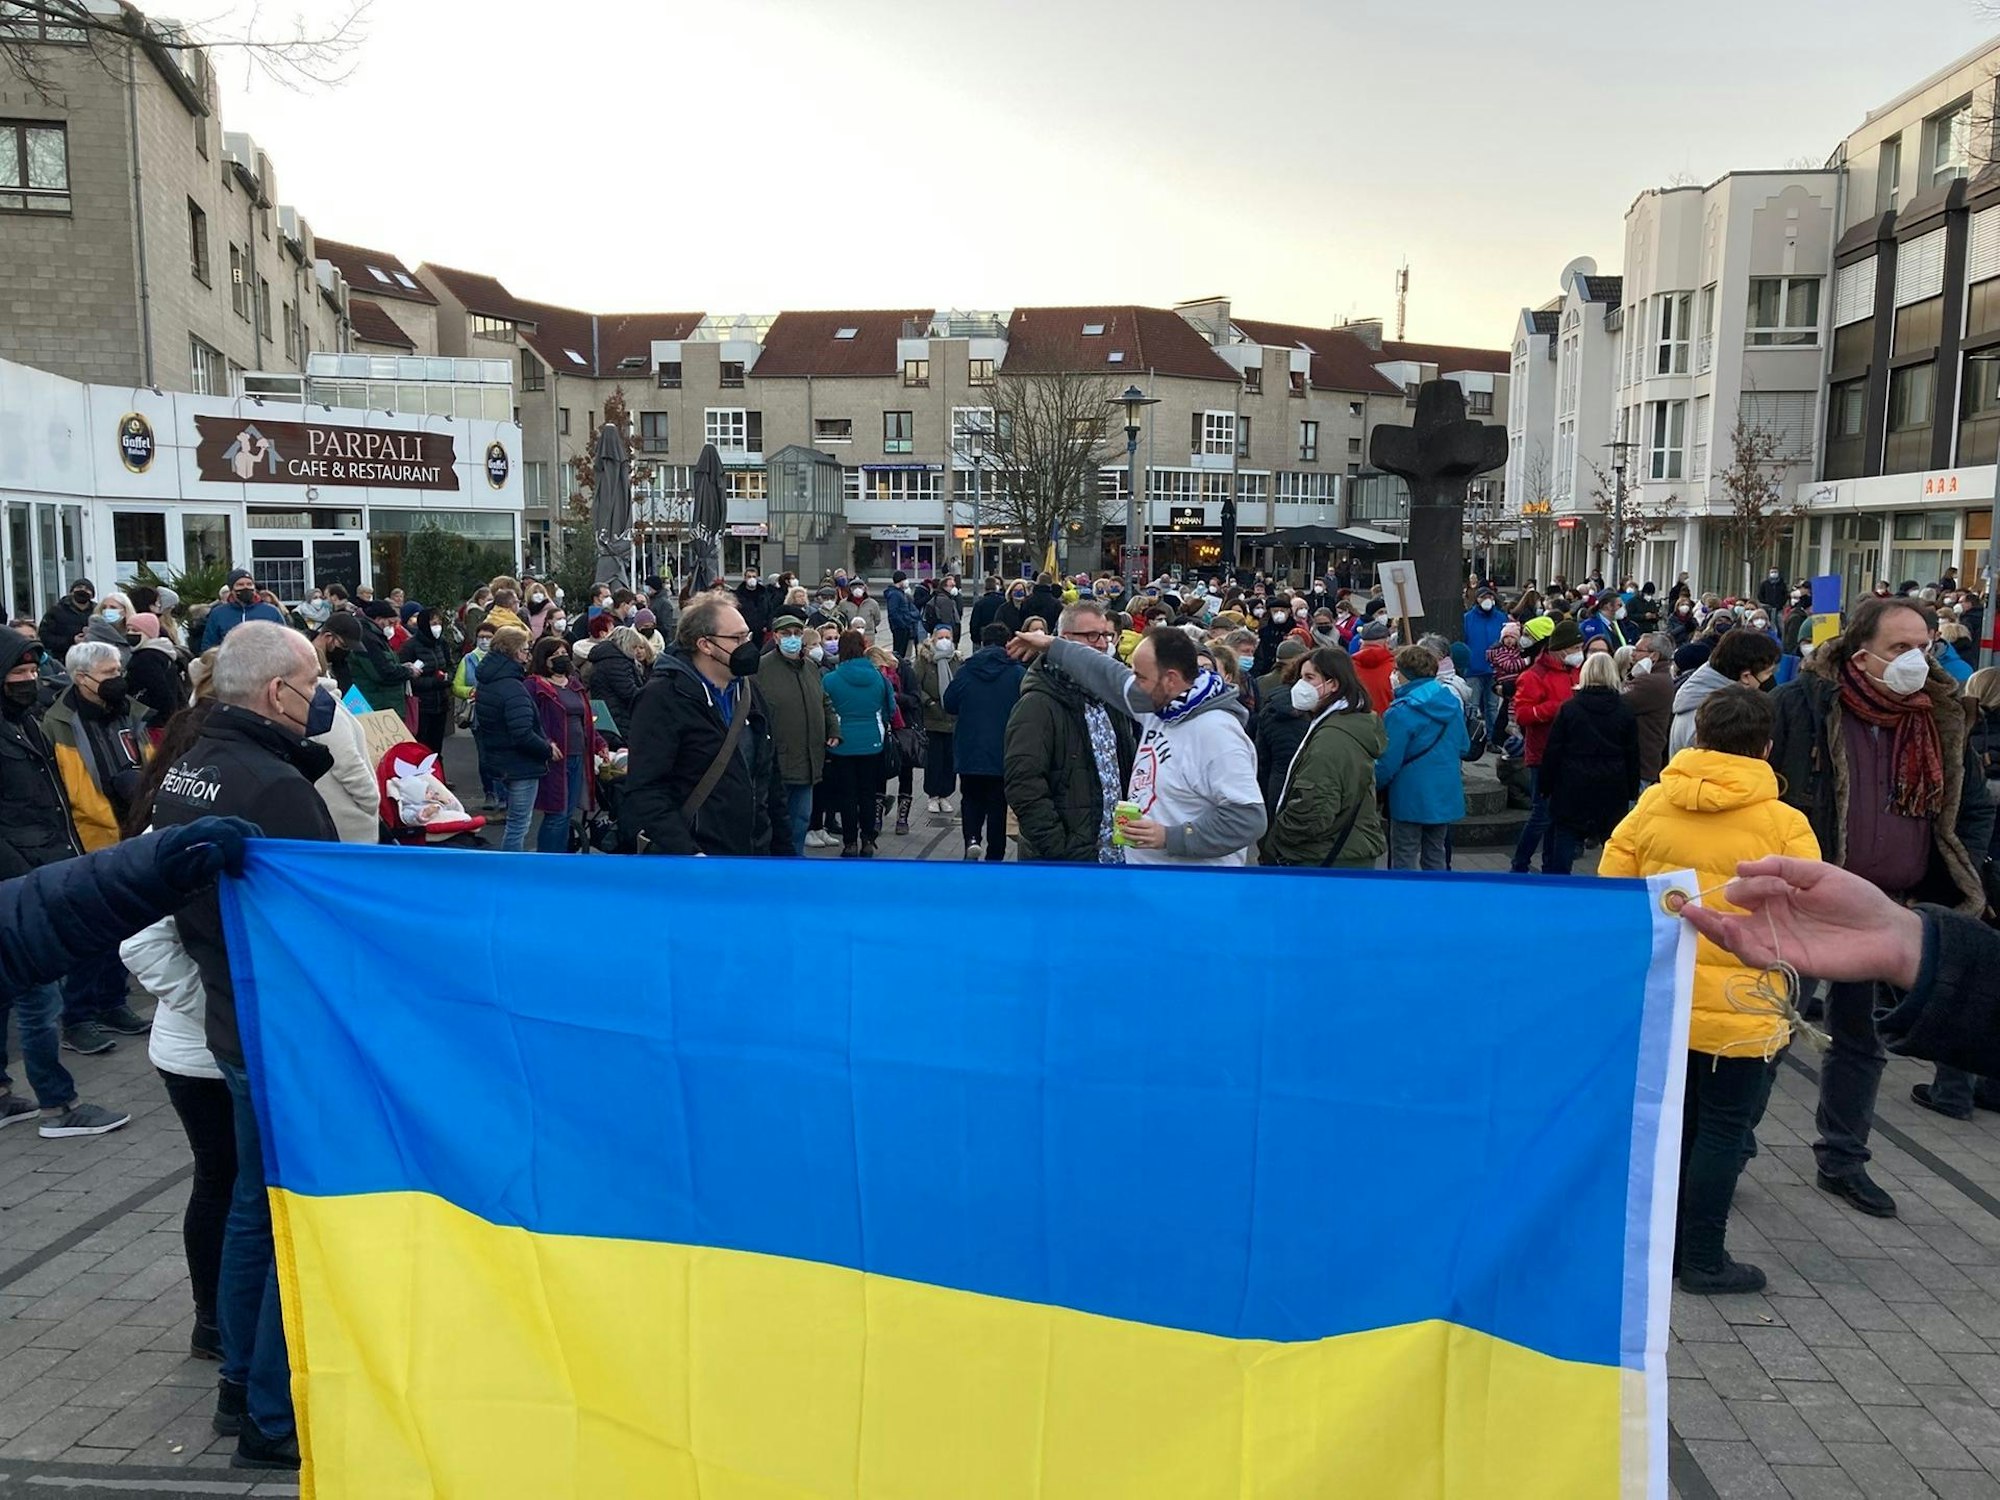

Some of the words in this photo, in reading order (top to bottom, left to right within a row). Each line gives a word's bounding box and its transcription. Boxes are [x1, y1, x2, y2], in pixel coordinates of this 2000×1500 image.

[122, 435, 150, 449] Gaffel
[307, 429, 424, 463] PARPALI
[288, 459, 328, 478] CAFE
[331, 463, 346, 478] &
[349, 463, 441, 482] RESTAURANT
[367, 714, 399, 735] NO
[160, 773, 221, 802] PEDITION
